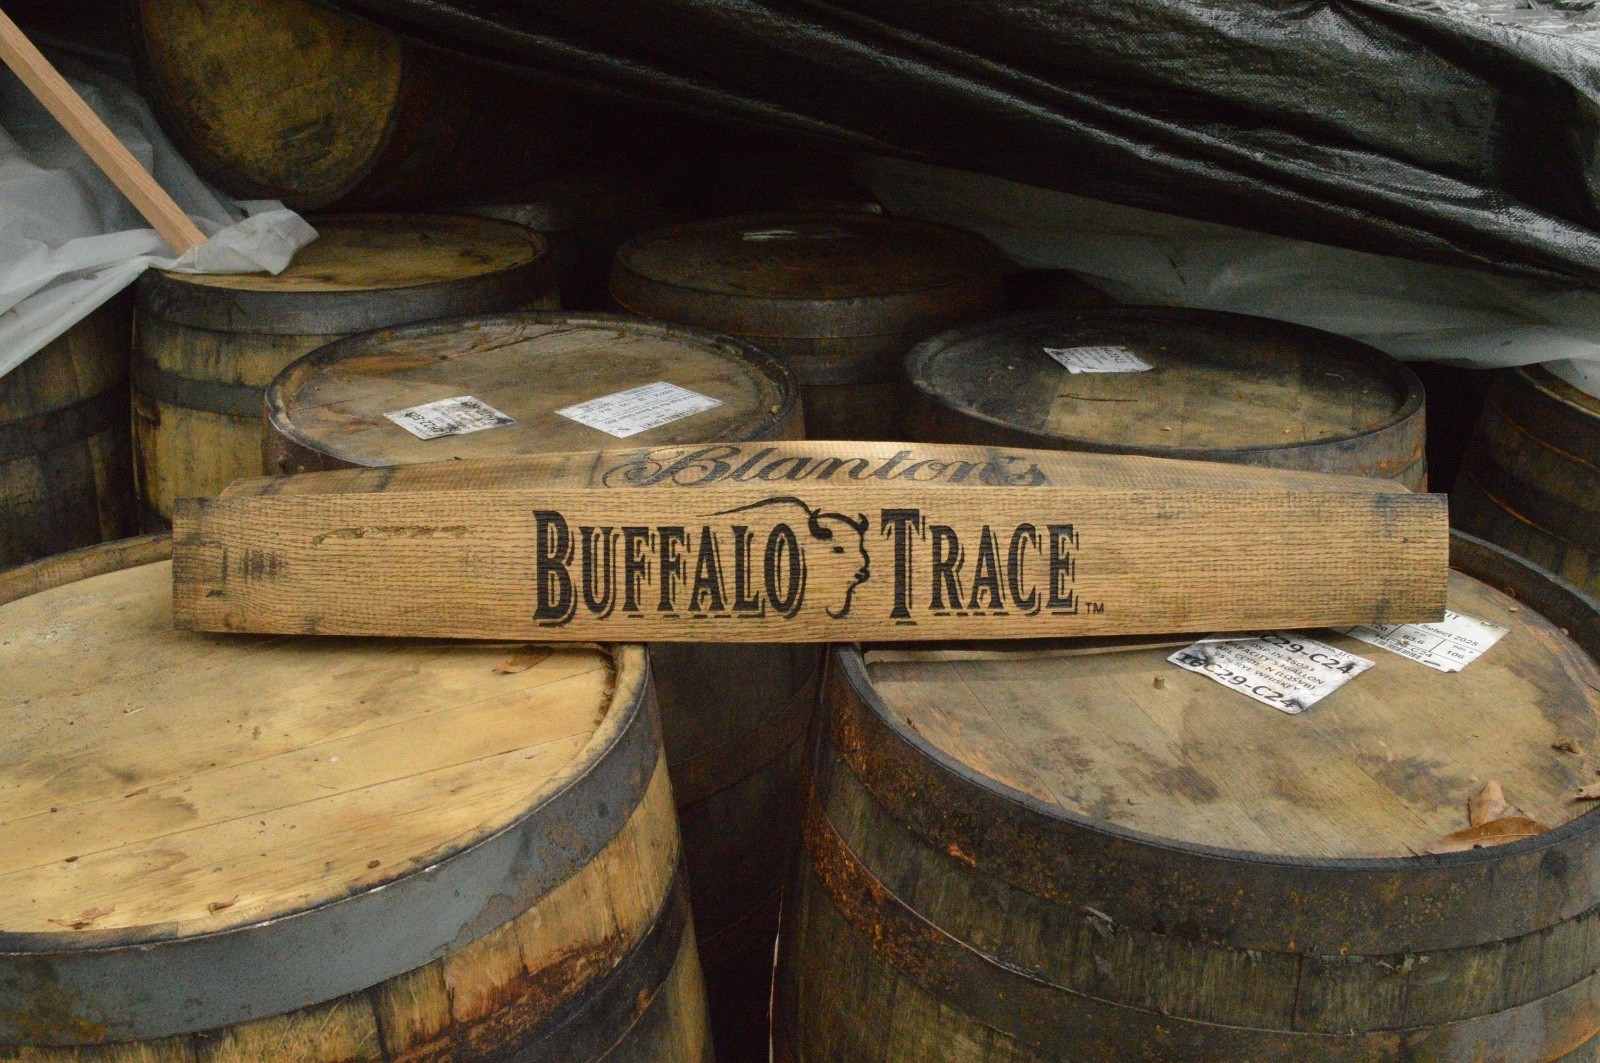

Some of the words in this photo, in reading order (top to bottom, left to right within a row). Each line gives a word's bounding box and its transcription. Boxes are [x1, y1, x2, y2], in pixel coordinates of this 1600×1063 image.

[602, 444, 1047, 488] Blanton's
[533, 510, 807, 628] BUFFALO
[881, 508, 1079, 626] TRACE
[1420, 624, 1452, 637] Select
[1254, 671, 1301, 691] WHISKEY
